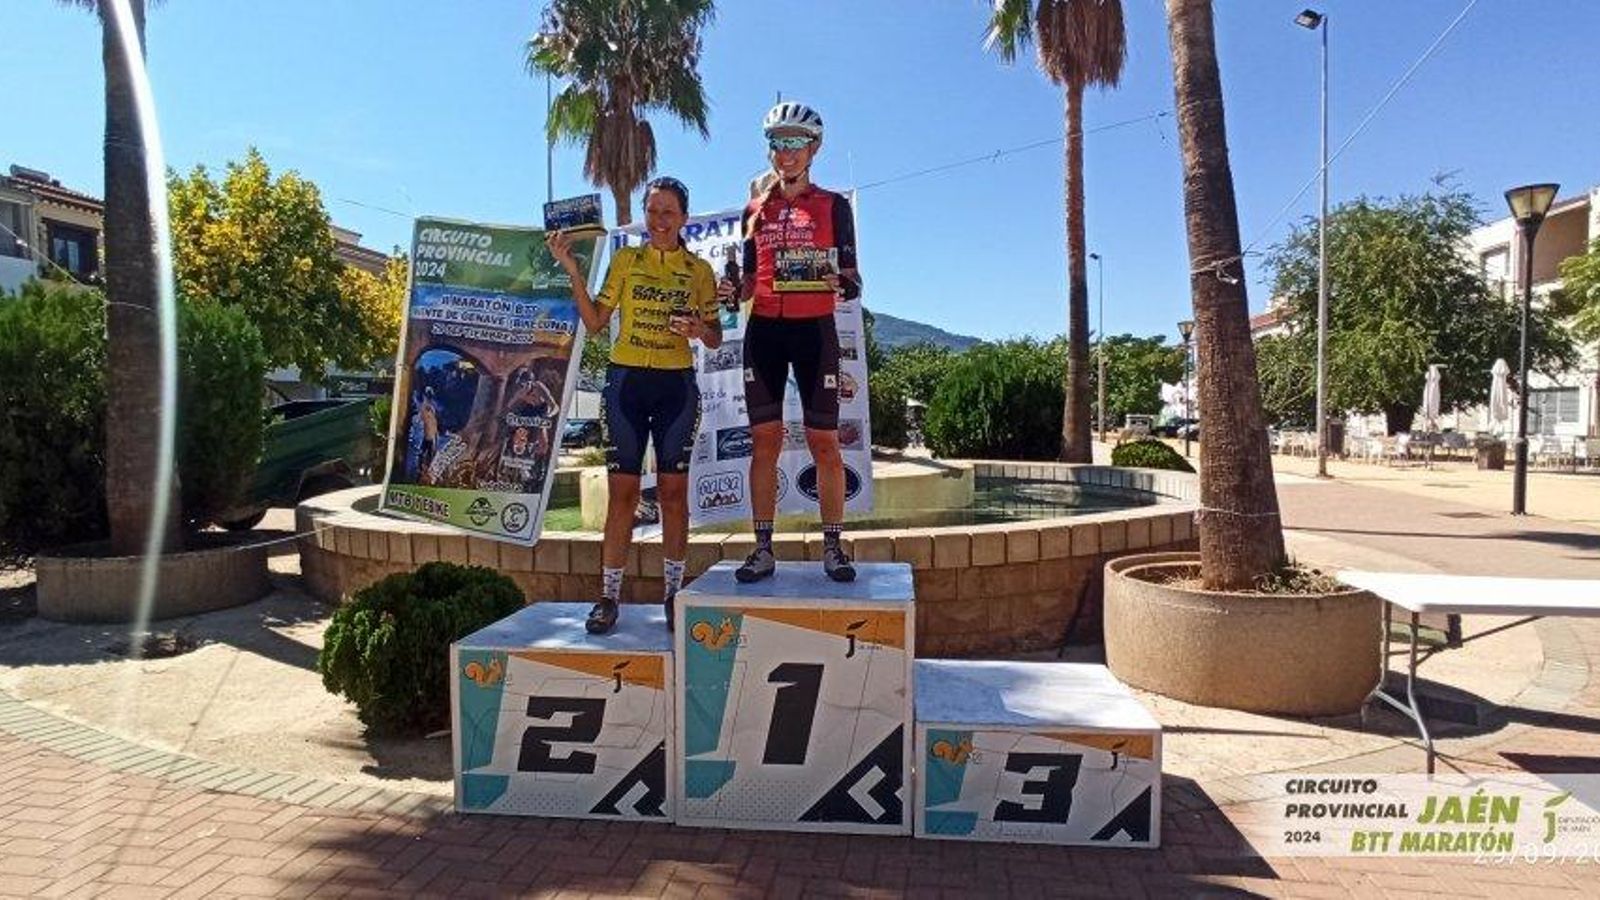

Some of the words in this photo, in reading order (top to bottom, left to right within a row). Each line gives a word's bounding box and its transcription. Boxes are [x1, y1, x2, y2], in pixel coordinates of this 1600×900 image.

[416, 244, 512, 266] PROVINCIAL
[420, 228, 492, 248] CIRCUITO
[452, 295, 510, 313] MARATÓN
[517, 696, 606, 774] 2
[762, 662, 825, 765] 1
[993, 752, 1083, 823] 3
